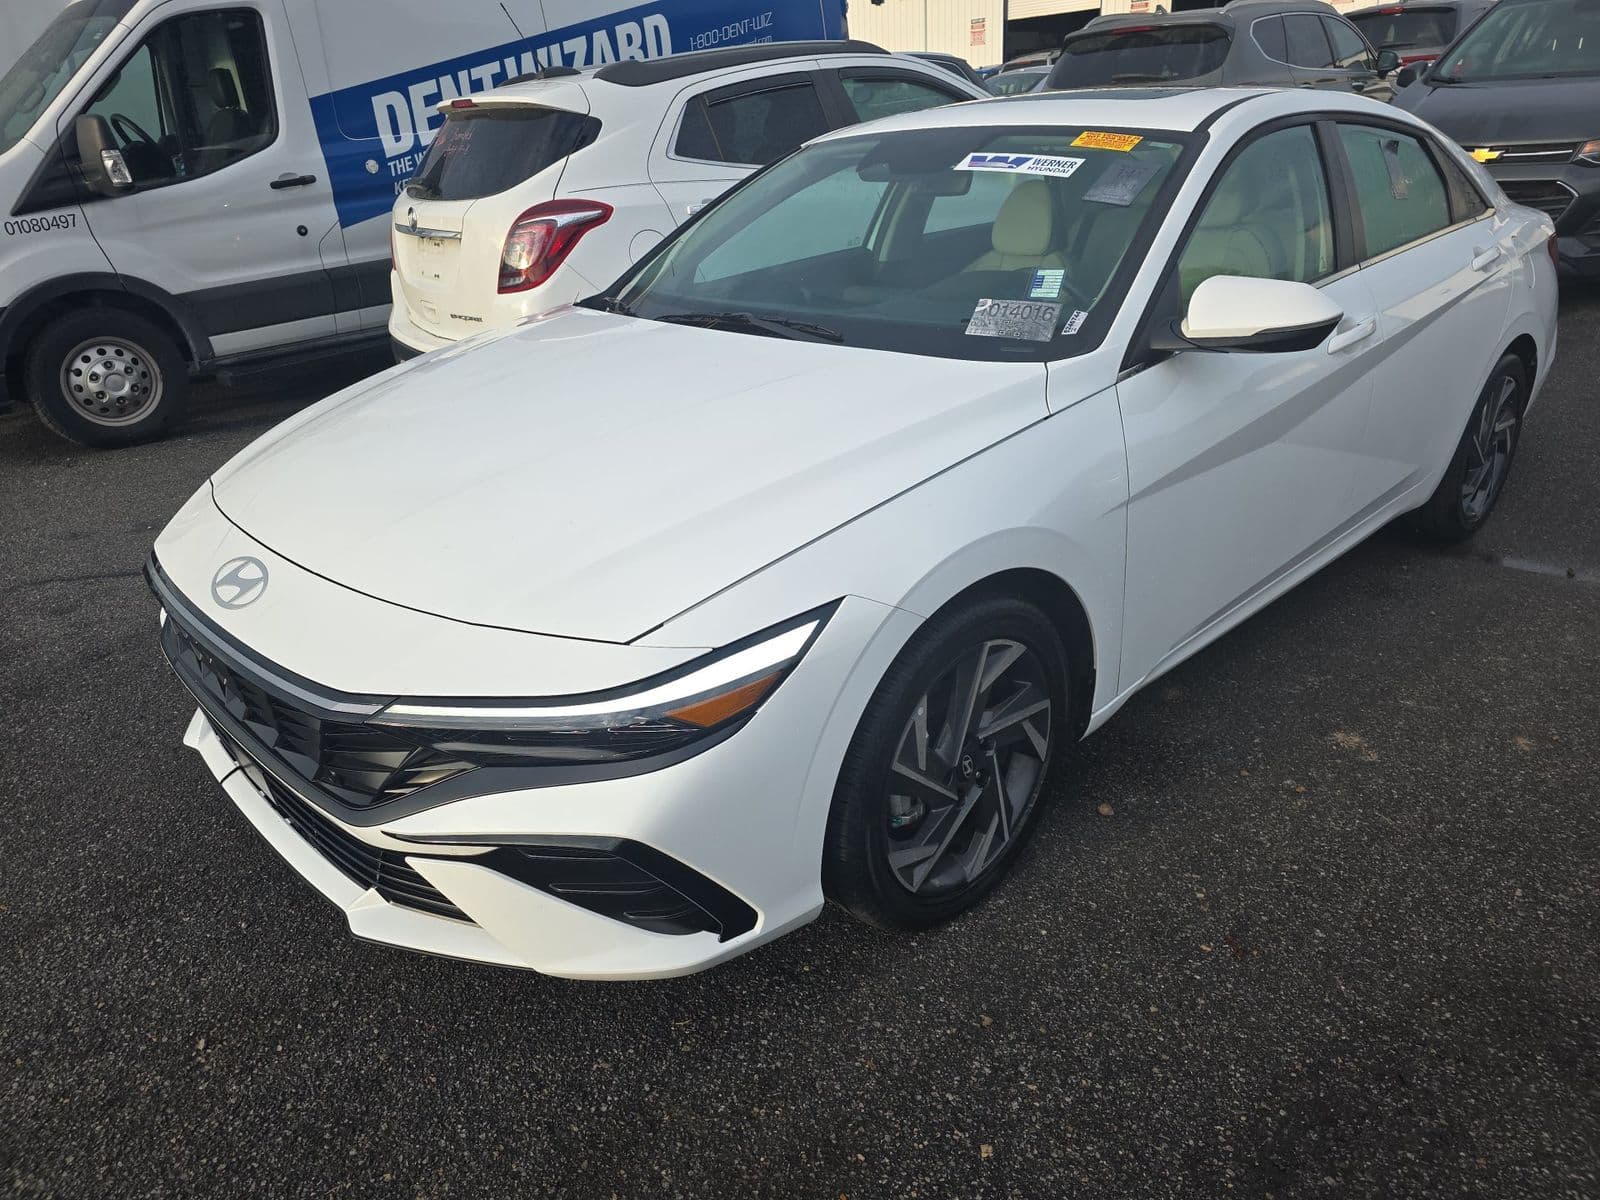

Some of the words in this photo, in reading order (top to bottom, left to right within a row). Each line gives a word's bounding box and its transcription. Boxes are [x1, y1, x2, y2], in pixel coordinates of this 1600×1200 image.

[690, 12, 774, 51] 1-800-DENT-WIZ
[387, 155, 414, 177] THE
[1027, 166, 1070, 174] HYUNDAI
[1032, 158, 1078, 169] WERNER
[4, 213, 76, 235] 01080497
